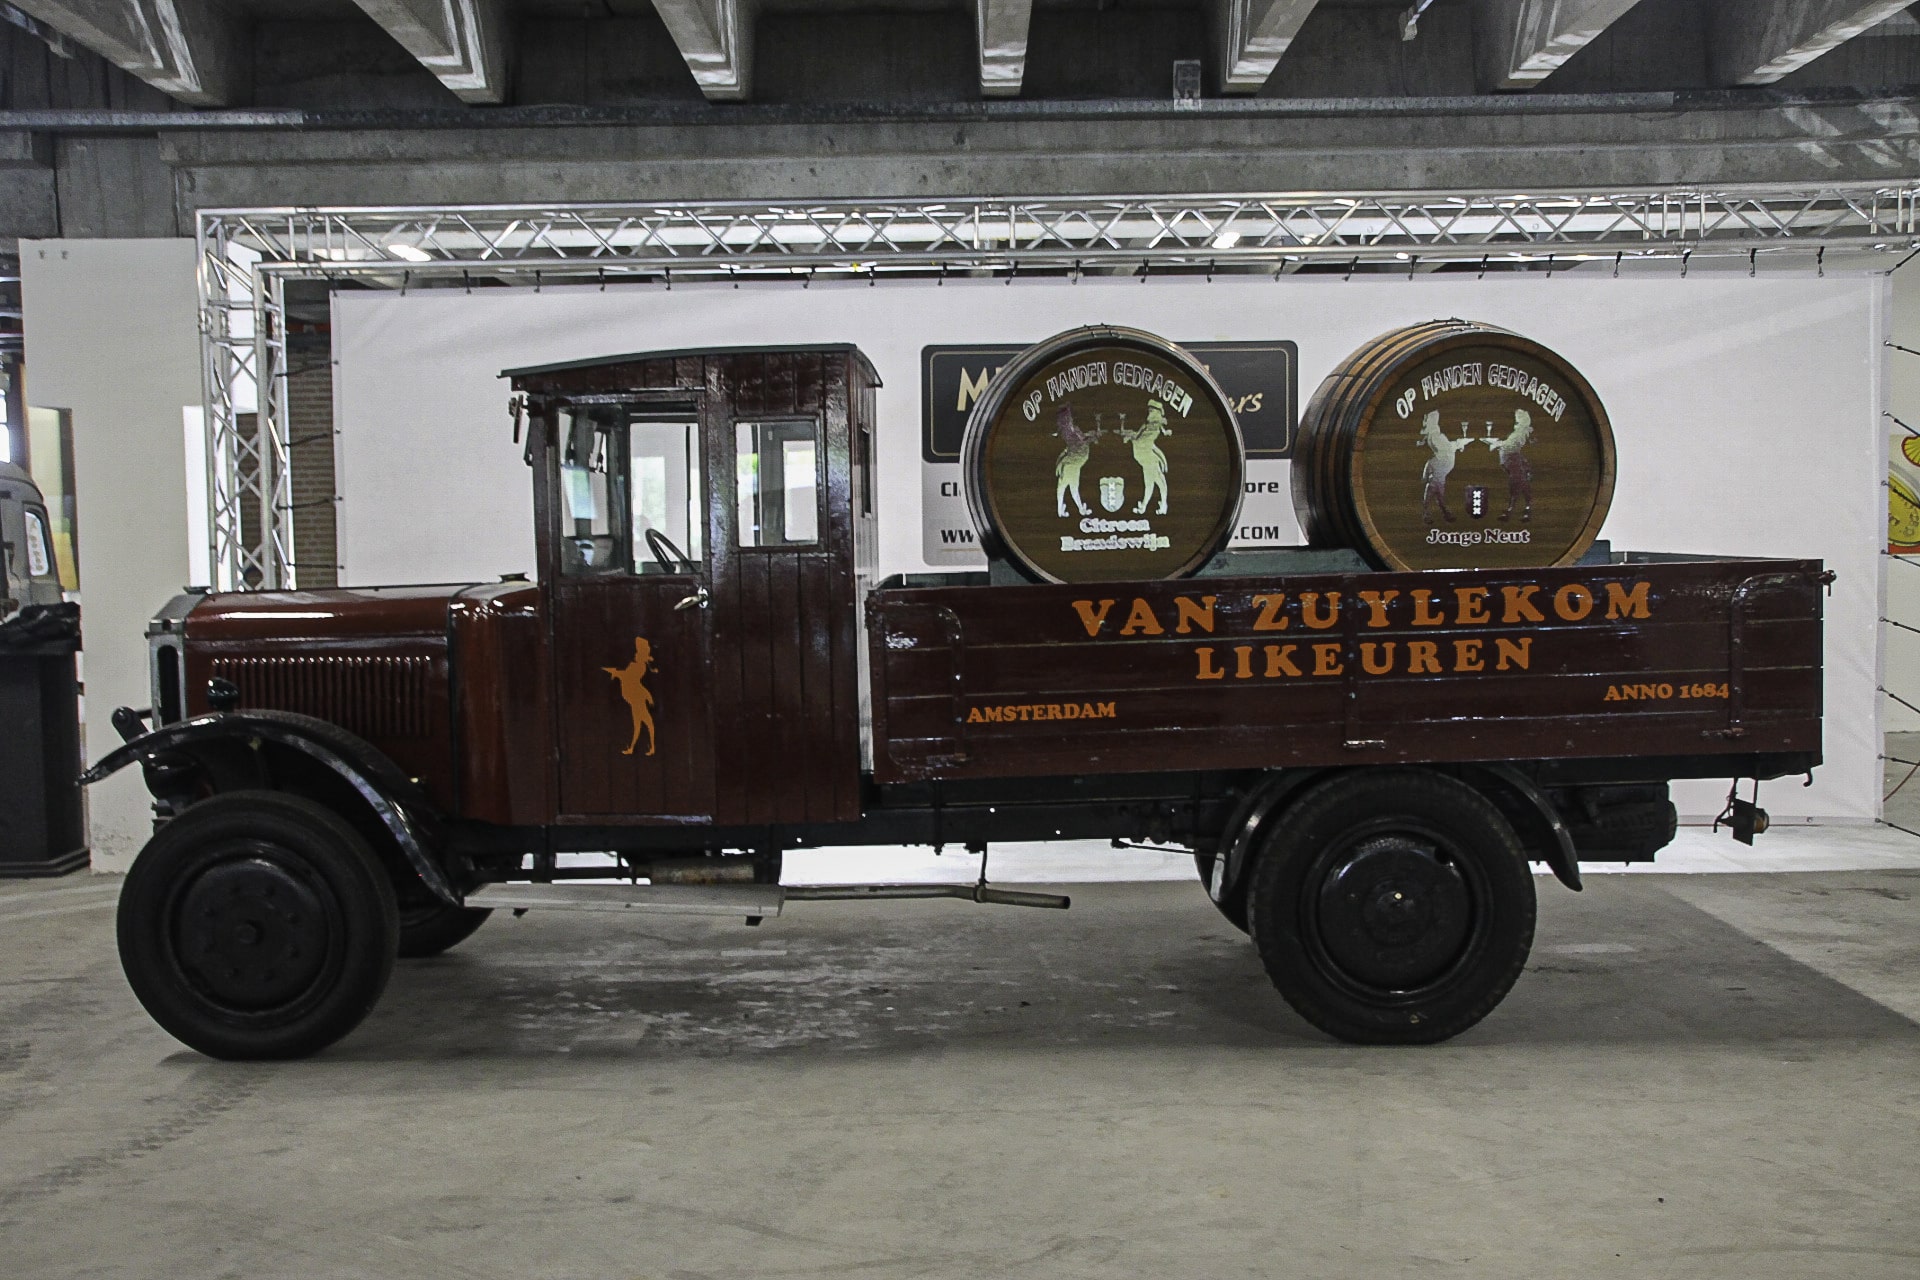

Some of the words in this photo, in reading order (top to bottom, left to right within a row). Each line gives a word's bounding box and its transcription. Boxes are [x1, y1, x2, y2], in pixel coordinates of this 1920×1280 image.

[1022, 390, 1042, 422] OP
[1046, 362, 1107, 402] HANDEN
[1113, 362, 1193, 418] GEDRAGEN
[1396, 388, 1416, 419] OP
[1421, 363, 1482, 400] HANDEN
[1488, 364, 1567, 422] GEDRAGEN
[1427, 529, 1481, 547] Jonge
[1484, 529, 1531, 544] Neut
[1072, 595, 1217, 637] VAN
[1252, 582, 1651, 630] ZUYLEKOM
[1195, 637, 1533, 680] LIKEUREN
[966, 702, 1117, 724] AMSTERDAM
[1603, 682, 1674, 702] ANNO
[1679, 683, 1730, 700] 1684
